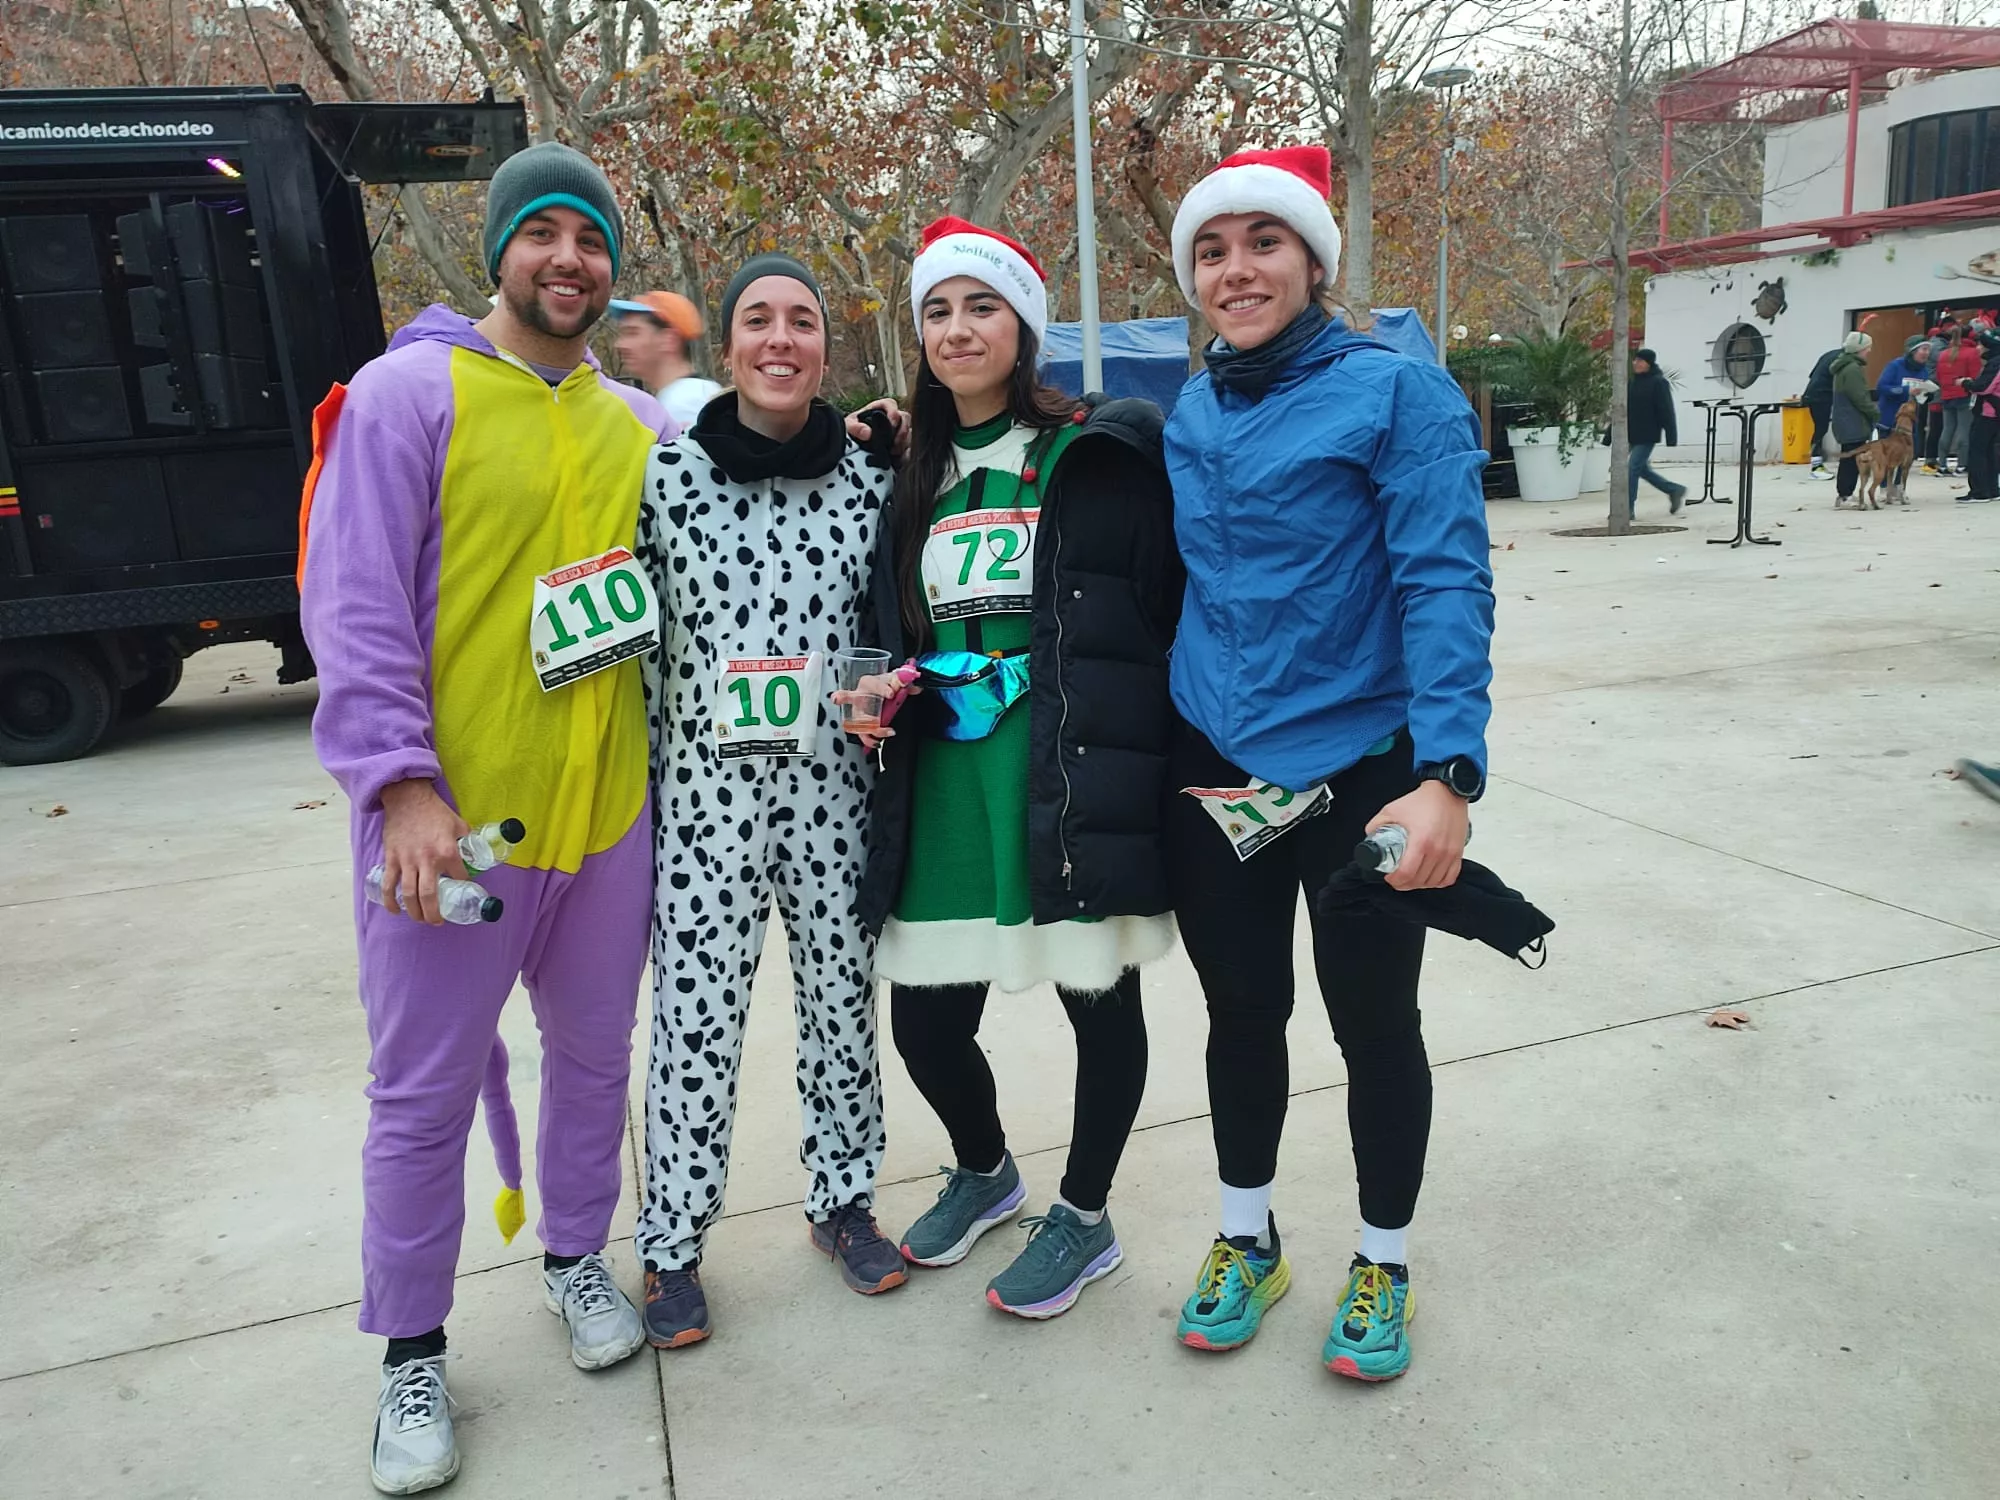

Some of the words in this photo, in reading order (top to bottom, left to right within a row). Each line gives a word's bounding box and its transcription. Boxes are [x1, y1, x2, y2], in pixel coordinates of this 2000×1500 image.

[952, 244, 1003, 270] Nollaig
[952, 528, 1020, 586] 72
[538, 569, 647, 653] 110
[727, 675, 801, 728] 10
